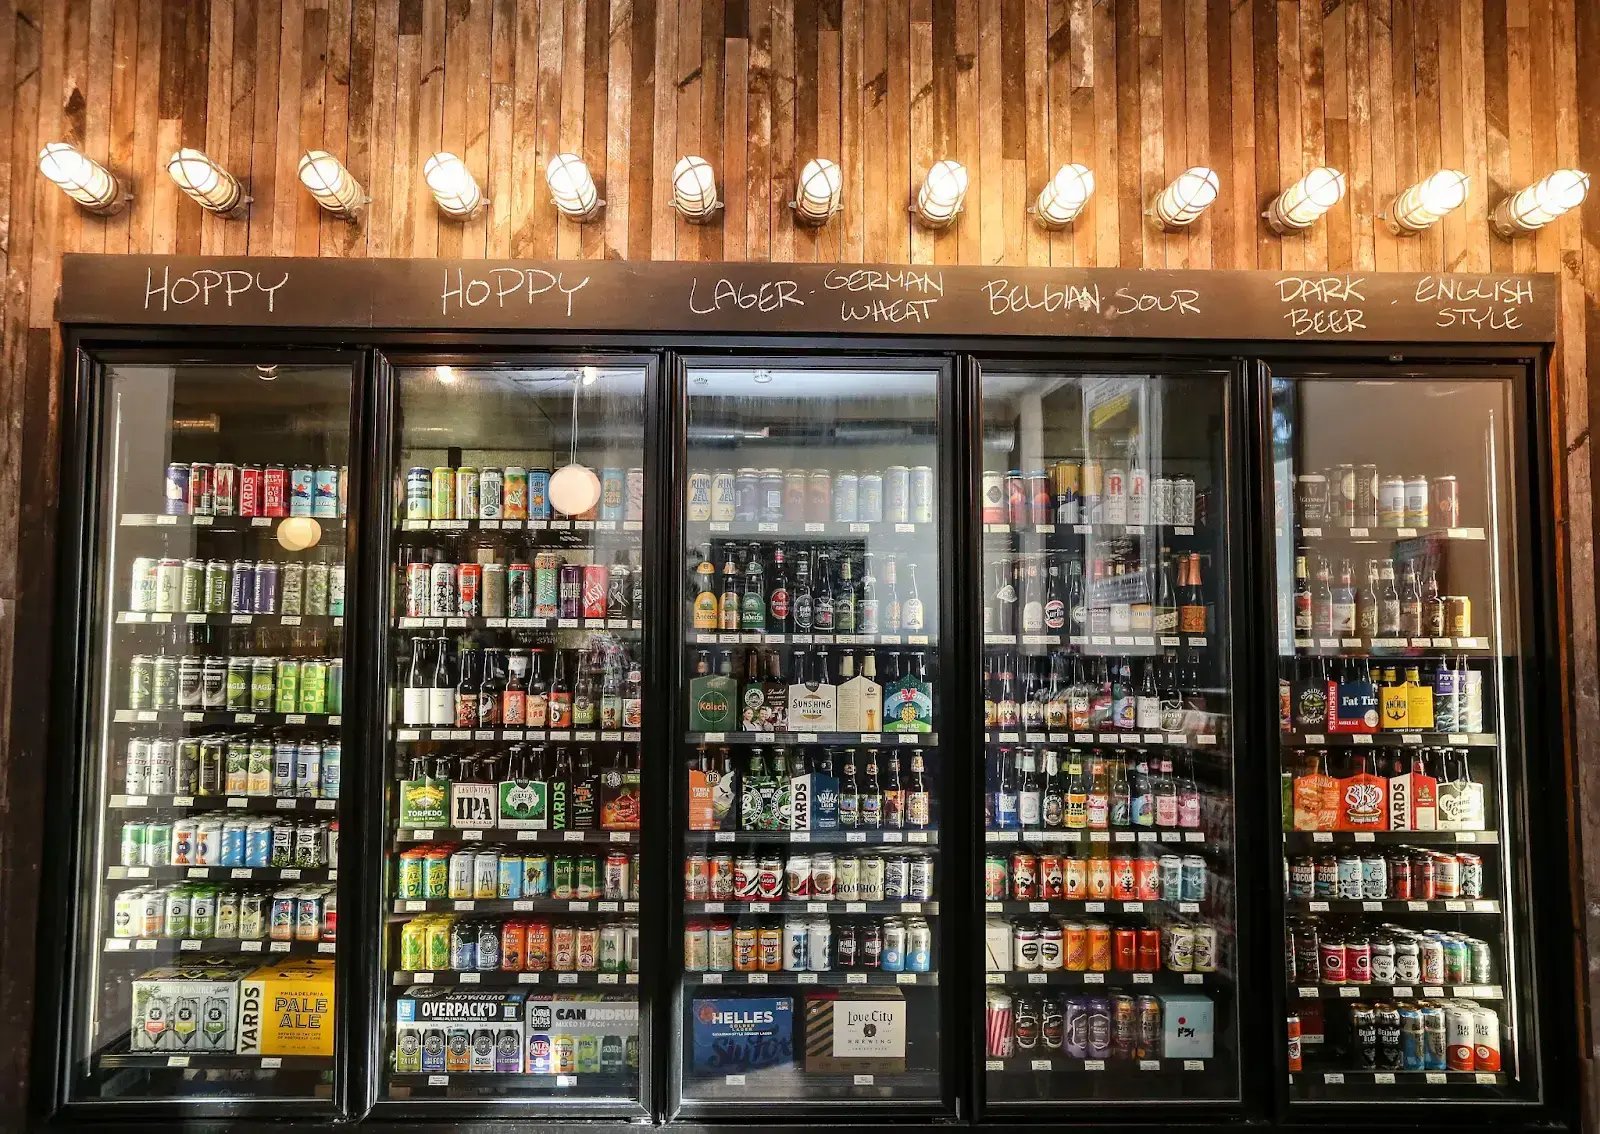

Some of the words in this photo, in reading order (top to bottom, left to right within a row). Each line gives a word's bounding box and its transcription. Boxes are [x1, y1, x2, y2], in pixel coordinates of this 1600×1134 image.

[144, 266, 289, 312] HOPPY
[441, 267, 590, 316] HOPPY
[824, 269, 943, 297] GERMAN
[1275, 276, 1365, 303] DARK
[1415, 276, 1533, 303] ENGLISH
[690, 277, 804, 315] LAGER
[981, 279, 1101, 315] BELGIAN
[1115, 283, 1200, 315] SOUR
[841, 298, 938, 323] WHEAT
[1284, 308, 1366, 335] BEER
[1436, 306, 1522, 329] STYLE
[243, 477, 254, 514] YARDS
[692, 479, 710, 488] RING
[700, 701, 727, 711] Kölsch
[793, 699, 832, 708] SUNSHINE
[1301, 688, 1327, 701] OBSIDIAN
[1342, 697, 1358, 706] Fat
[1360, 696, 1378, 706] Tire
[1302, 715, 1324, 724] STOUT
[457, 797, 492, 819] IPA
[553, 781, 565, 830] YARDS
[795, 783, 806, 830] YARDS
[1393, 783, 1405, 830] YARDS
[275, 998, 328, 1013] PALE
[422, 1002, 497, 1017] OVERPACK'D
[712, 1011, 773, 1024] HELLES
[848, 1011, 870, 1025] Love
[871, 1010, 893, 1025] City
[241, 987, 260, 1053] YARDS
[279, 1014, 322, 1029] ALE
[533, 1017, 550, 1025] BLUES
